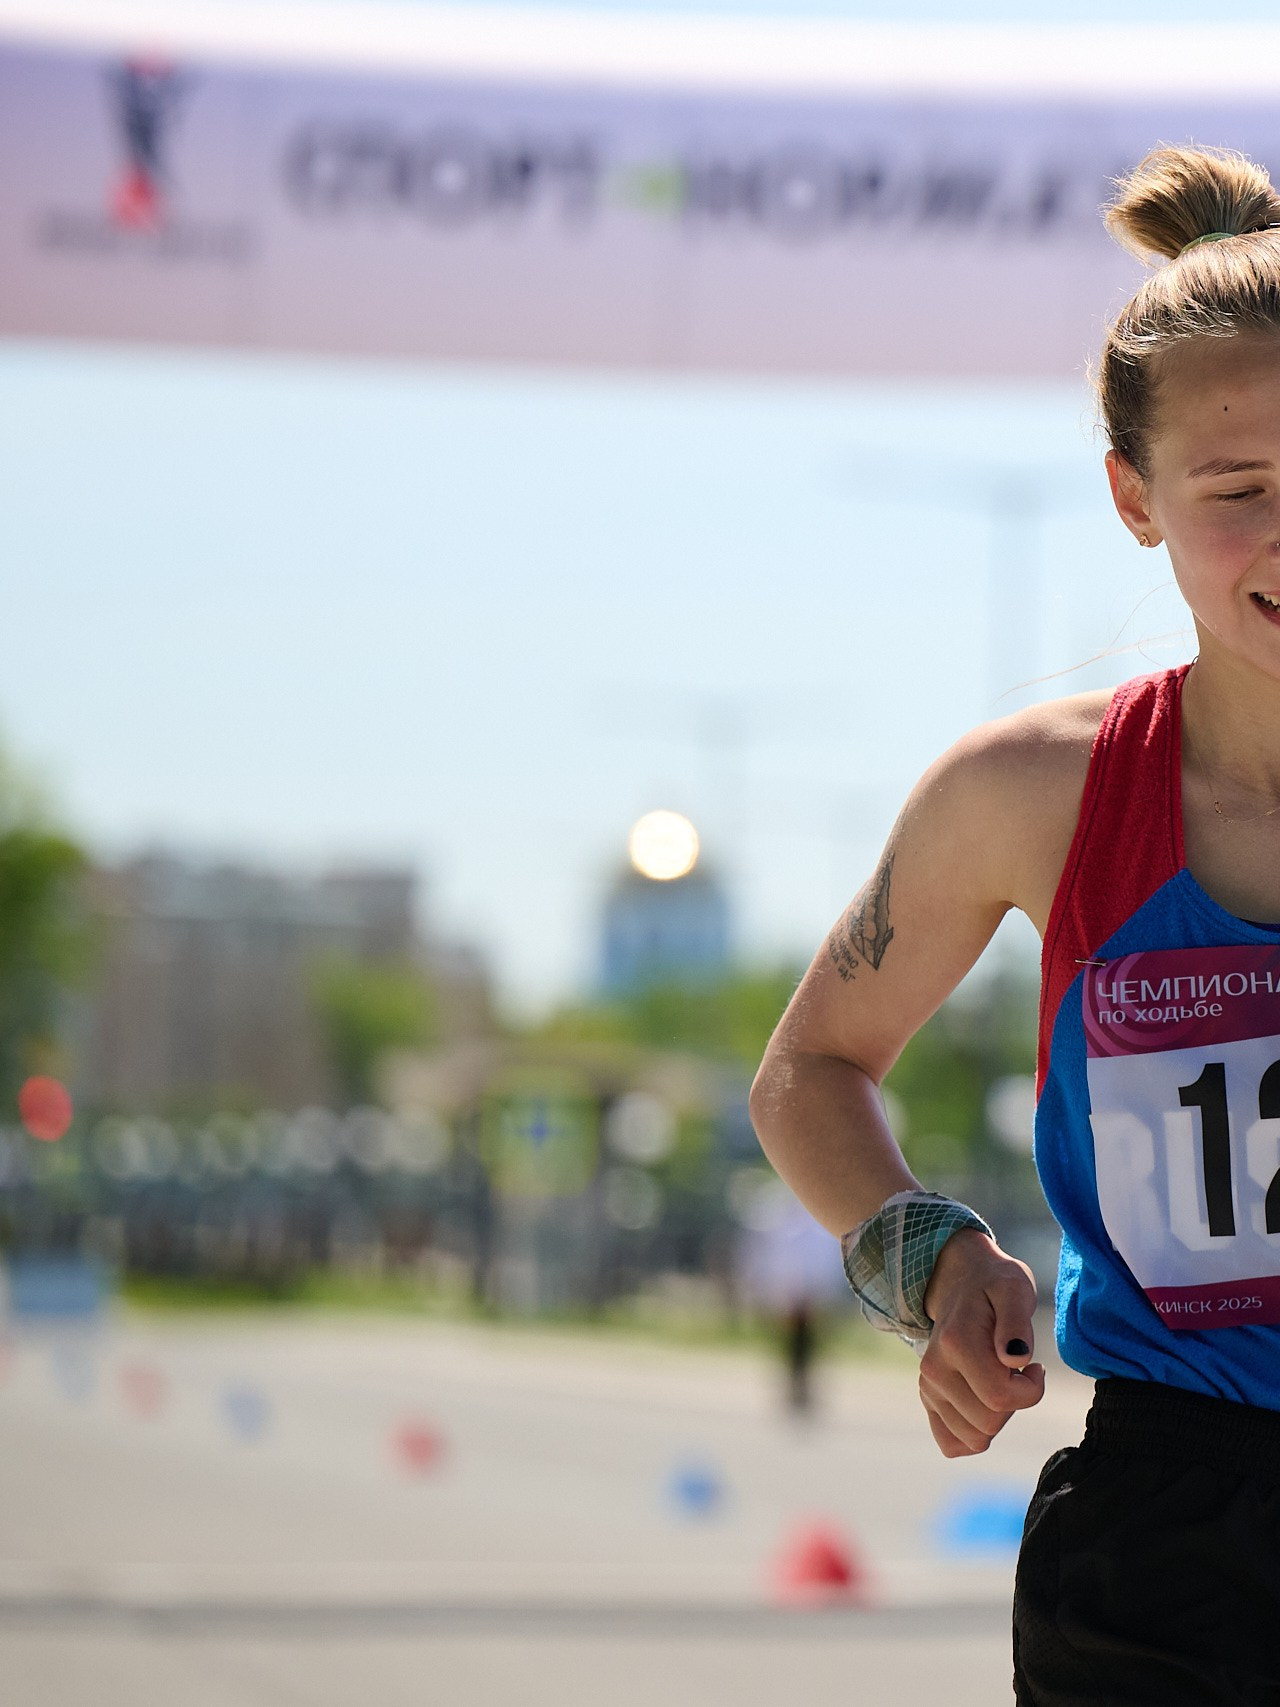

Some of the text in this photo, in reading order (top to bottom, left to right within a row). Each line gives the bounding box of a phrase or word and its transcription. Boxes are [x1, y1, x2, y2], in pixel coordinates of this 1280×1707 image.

[1099, 1000, 1223, 1024] по ходьбе
[1152, 1296, 1263, 1314] КИНСК 2025
